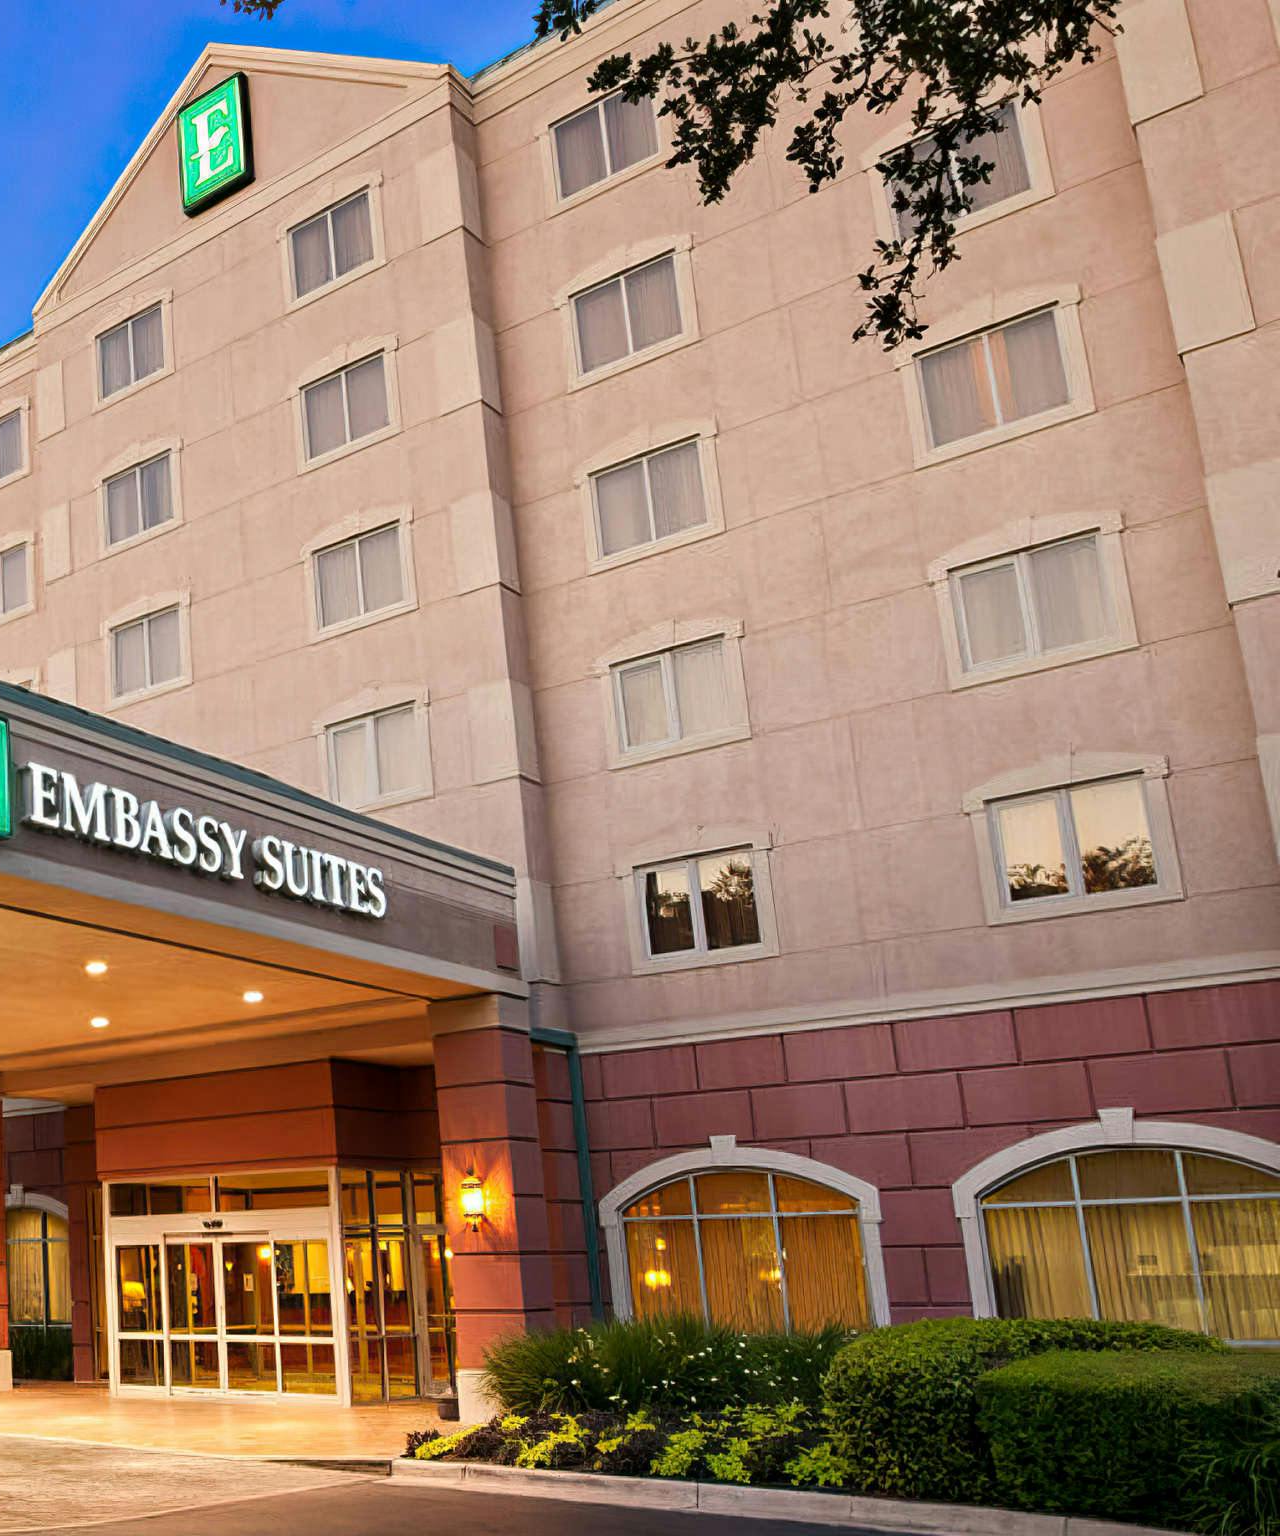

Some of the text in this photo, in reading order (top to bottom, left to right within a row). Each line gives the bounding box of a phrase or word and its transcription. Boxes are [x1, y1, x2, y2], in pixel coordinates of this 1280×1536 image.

[190, 98, 233, 187] E
[24, 761, 387, 918] EMBASSY SUITES
